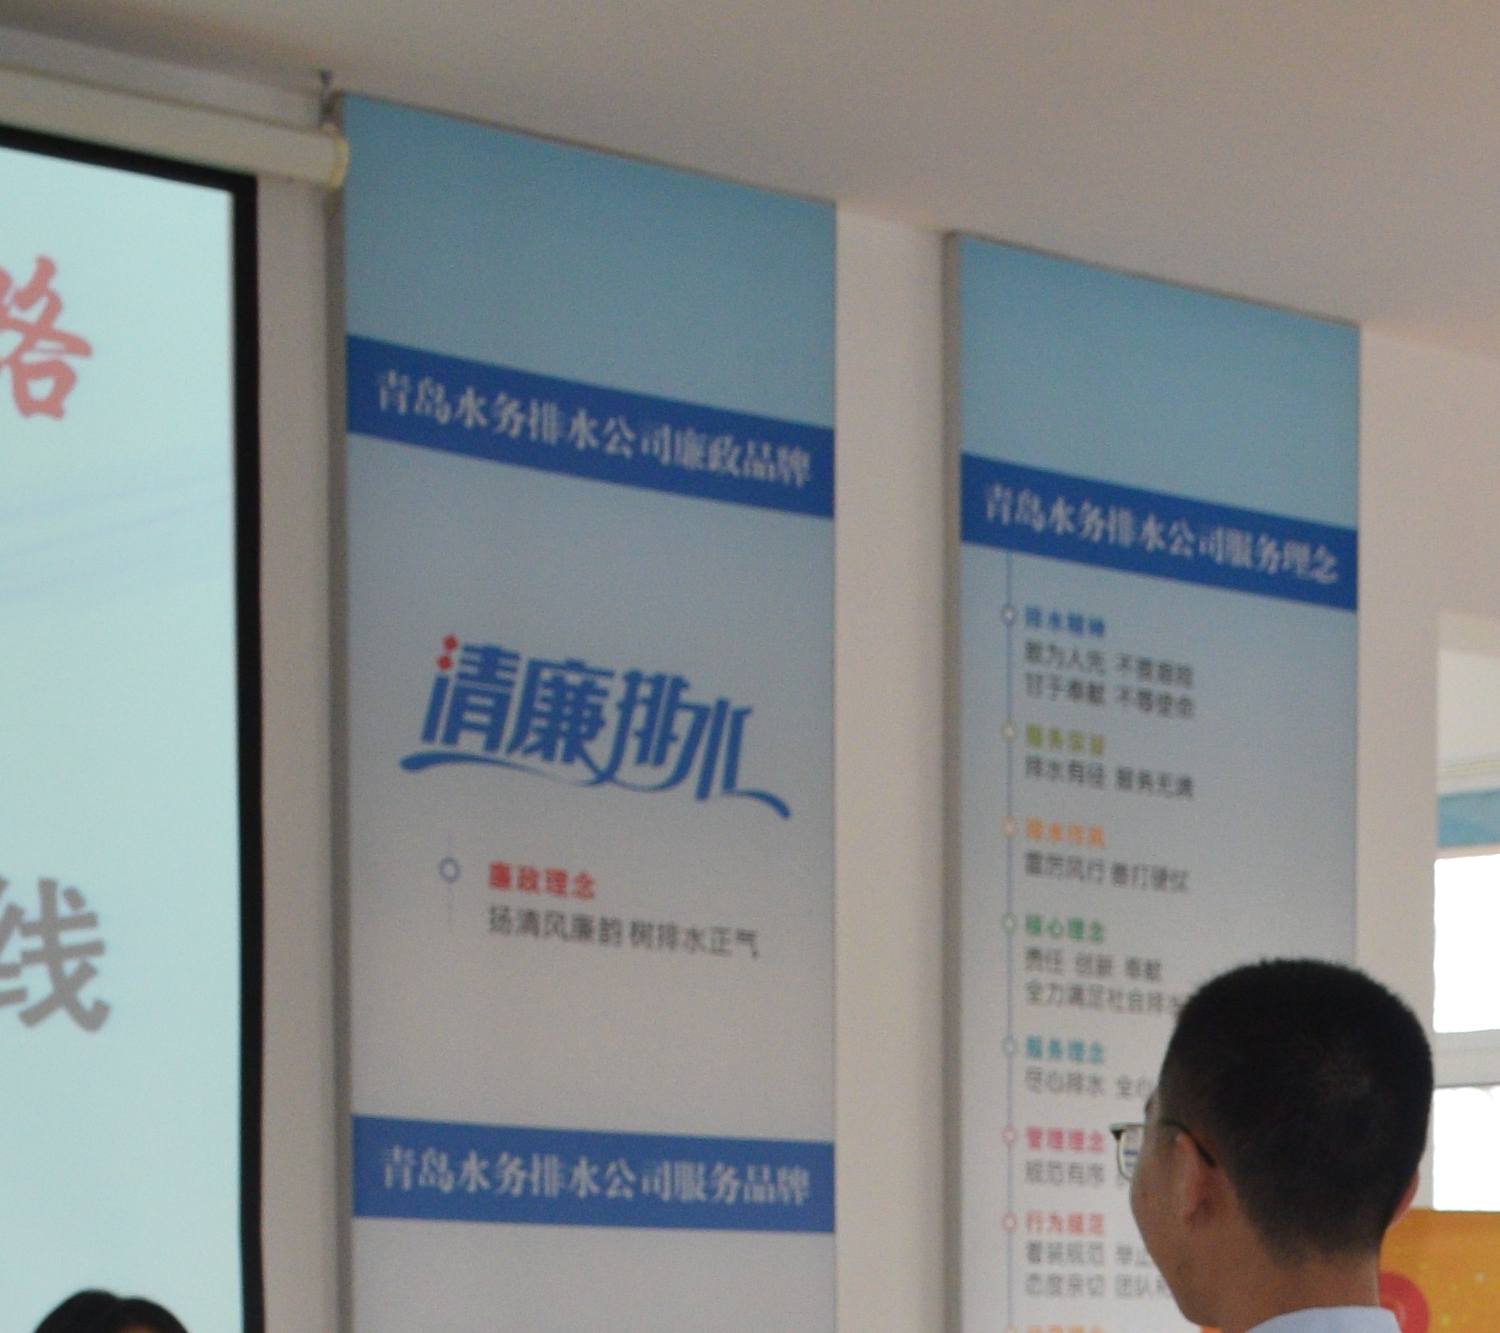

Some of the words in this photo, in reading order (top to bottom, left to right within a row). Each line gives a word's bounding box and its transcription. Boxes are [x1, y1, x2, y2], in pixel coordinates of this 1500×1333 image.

[377, 369, 812, 489] 青岛水务排水公司廉政品牌
[986, 483, 1339, 584] 青岛水务排水公司服务理念
[400, 634, 792, 820] 清廉排水
[489, 861, 596, 900] 廉政理念
[1026, 1035, 1104, 1064] 服务理念
[382, 1145, 810, 1208] 青岛水务排水公司服务品牌
